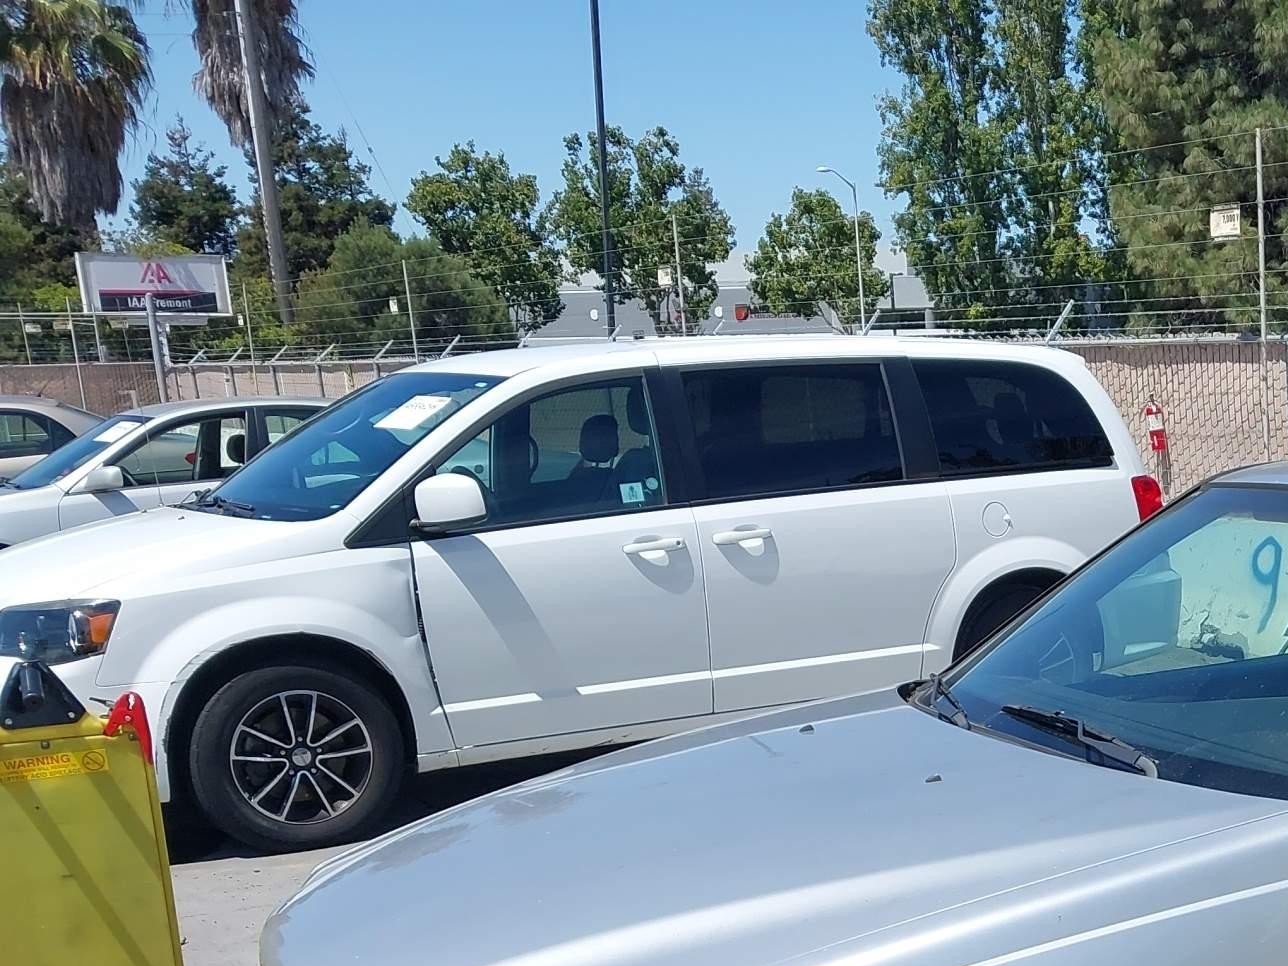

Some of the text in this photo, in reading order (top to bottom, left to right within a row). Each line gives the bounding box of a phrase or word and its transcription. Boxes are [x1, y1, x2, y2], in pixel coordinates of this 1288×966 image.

[128, 297, 147, 308] IAA
[1252, 535, 1282, 634] 9
[3, 754, 71, 770] WARNING
